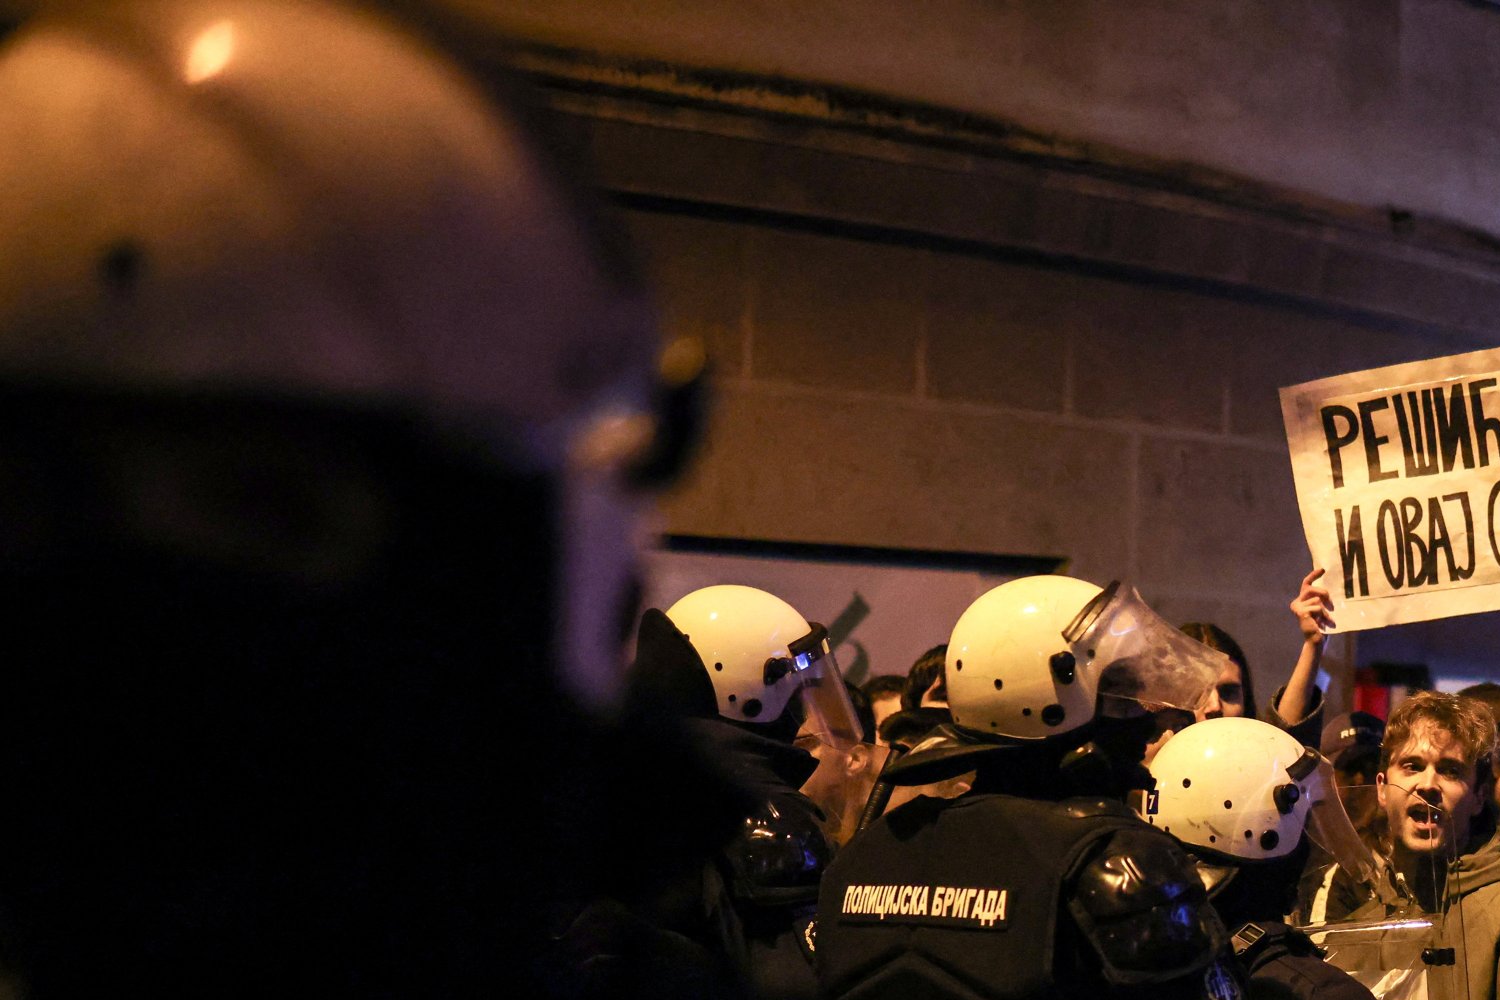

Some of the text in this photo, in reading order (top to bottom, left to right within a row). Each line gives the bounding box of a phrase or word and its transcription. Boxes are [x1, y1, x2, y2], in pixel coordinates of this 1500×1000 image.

[1334, 504, 1369, 598] И
[1376, 491, 1475, 590] ОВАЈ
[842, 885, 1007, 926] ПОЛИЦИЈСКА БРИГАДА
